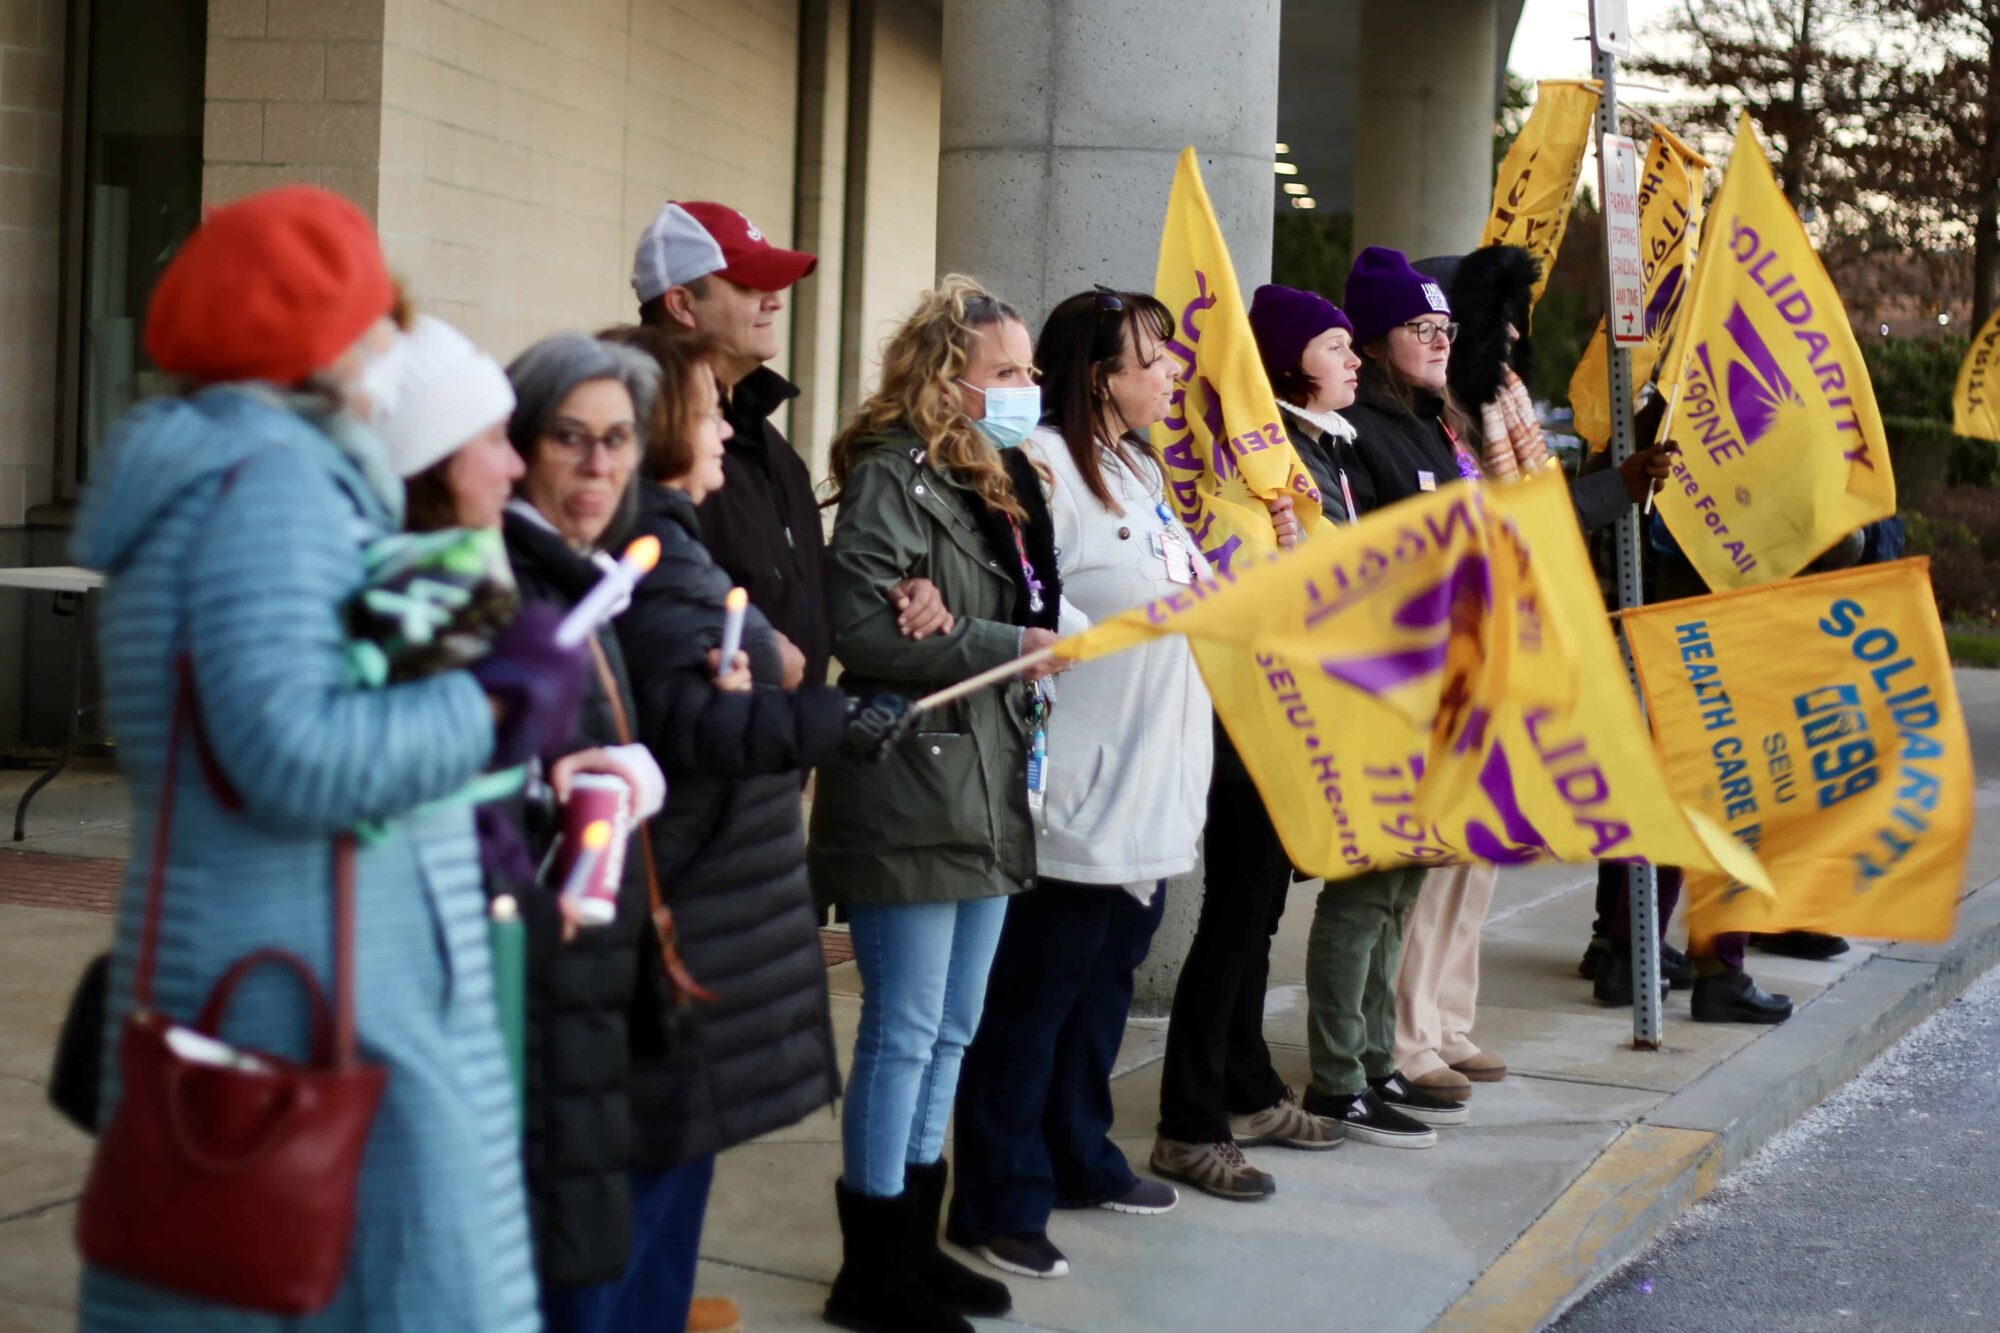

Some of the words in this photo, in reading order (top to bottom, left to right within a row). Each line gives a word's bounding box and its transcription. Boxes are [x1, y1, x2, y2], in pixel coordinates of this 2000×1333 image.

[1610, 192, 1635, 215] PARKING
[1612, 226, 1637, 247] STOPPING
[1613, 255, 1639, 277] STANDING
[1616, 286, 1626, 306] ANY
[1627, 288, 1640, 308] TIME
[1694, 495, 1729, 536] For
[1722, 540, 1757, 575] All
[1675, 620, 1737, 731] HEALTH
[1712, 736, 1759, 821] CARE
[1763, 732, 1798, 804] SEIU
[1818, 598, 1944, 892] SOLIDARITY
